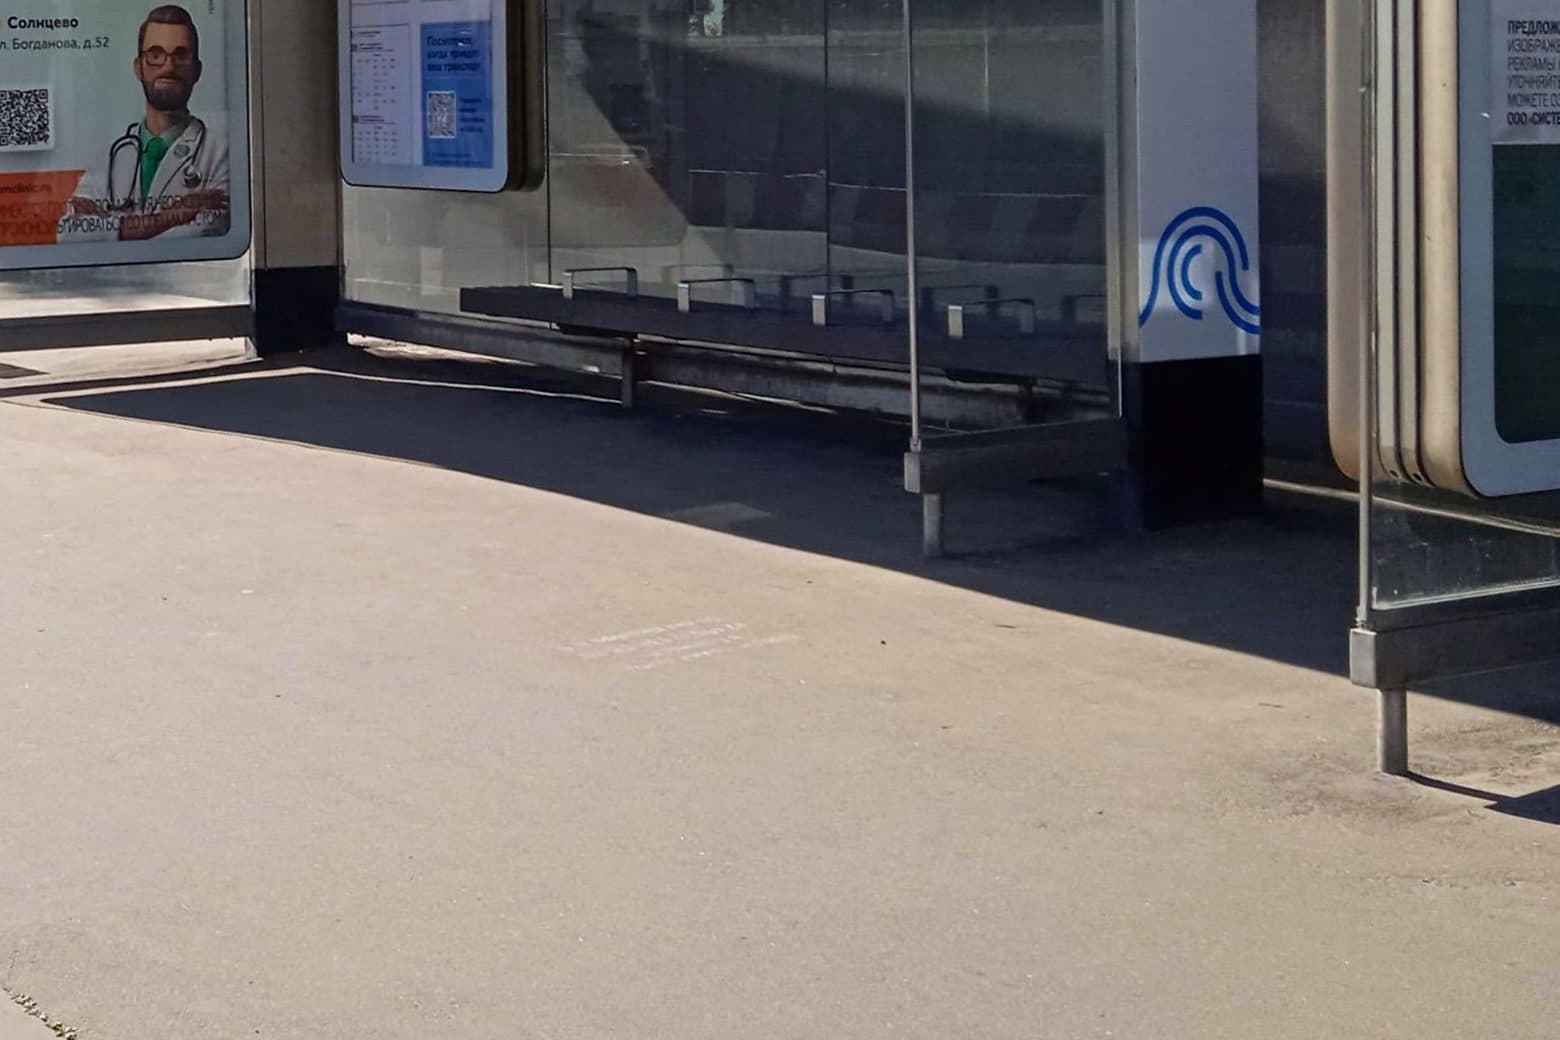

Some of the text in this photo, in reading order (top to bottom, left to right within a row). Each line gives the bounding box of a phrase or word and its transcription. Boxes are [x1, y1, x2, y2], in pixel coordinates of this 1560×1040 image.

[7, 16, 79, 30] Солнцево
[13, 38, 81, 50] Богданова,
[83, 36, 110, 48] д.52
